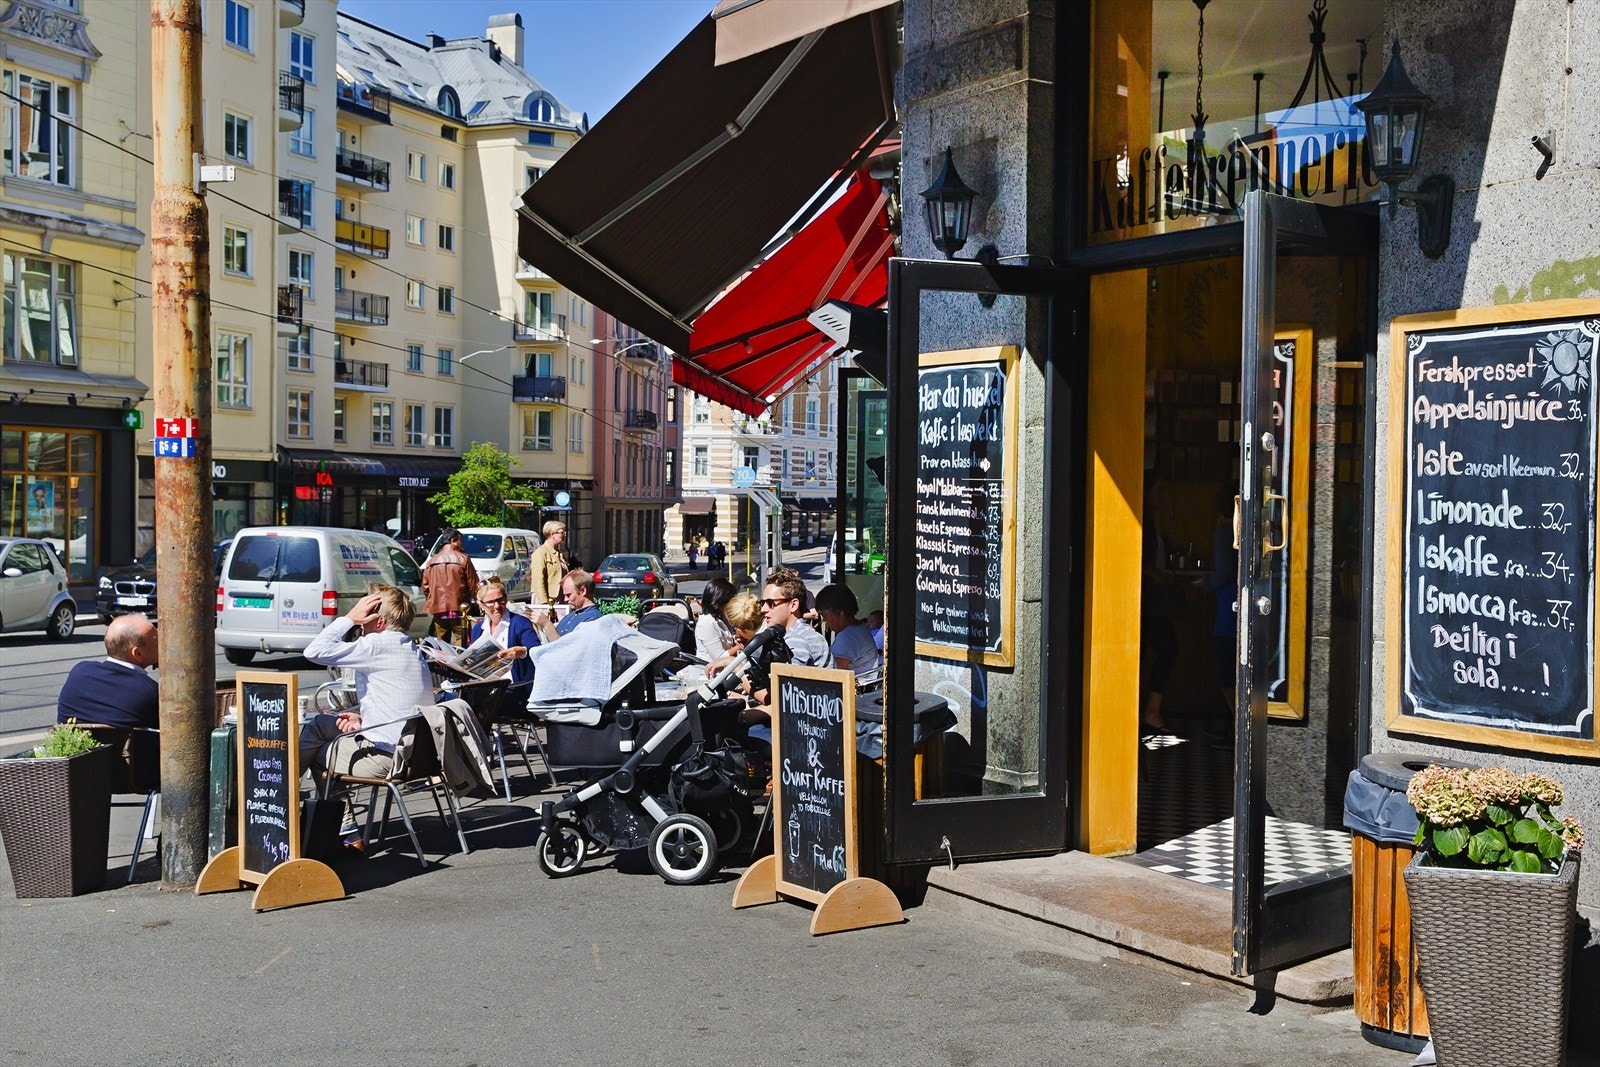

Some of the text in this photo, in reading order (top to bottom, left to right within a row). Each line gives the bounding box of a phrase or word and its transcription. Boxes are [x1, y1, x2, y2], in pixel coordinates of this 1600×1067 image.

[1418, 347, 1538, 391] Ferskpresset
[918, 383, 941, 412] Har
[942, 373, 960, 408] du
[1414, 389, 1567, 429] Appelsinjuice
[920, 417, 948, 448] Kaffe
[950, 417, 956, 442] i
[940, 458, 950, 468] en
[1417, 441, 1464, 477] Iste
[1464, 461, 1480, 475] av
[1481, 454, 1508, 478] sort
[316, 472, 333, 485] ICA
[399, 477, 419, 487] STUDIO
[1417, 488, 1526, 529] Limonade
[940, 521, 972, 537] Espresso
[947, 539, 979, 557] Espresso
[1418, 534, 1499, 577] Iskaffe
[952, 579, 982, 598] Espresso
[1418, 575, 1505, 621] Ismocca
[921, 602, 934, 613] Noe
[935, 602, 945, 616] for
[1430, 621, 1518, 666] Deilig i
[256, 715, 280, 732] KAFFE
[808, 738, 825, 768] &
[782, 758, 845, 796] SVART KAFFE
